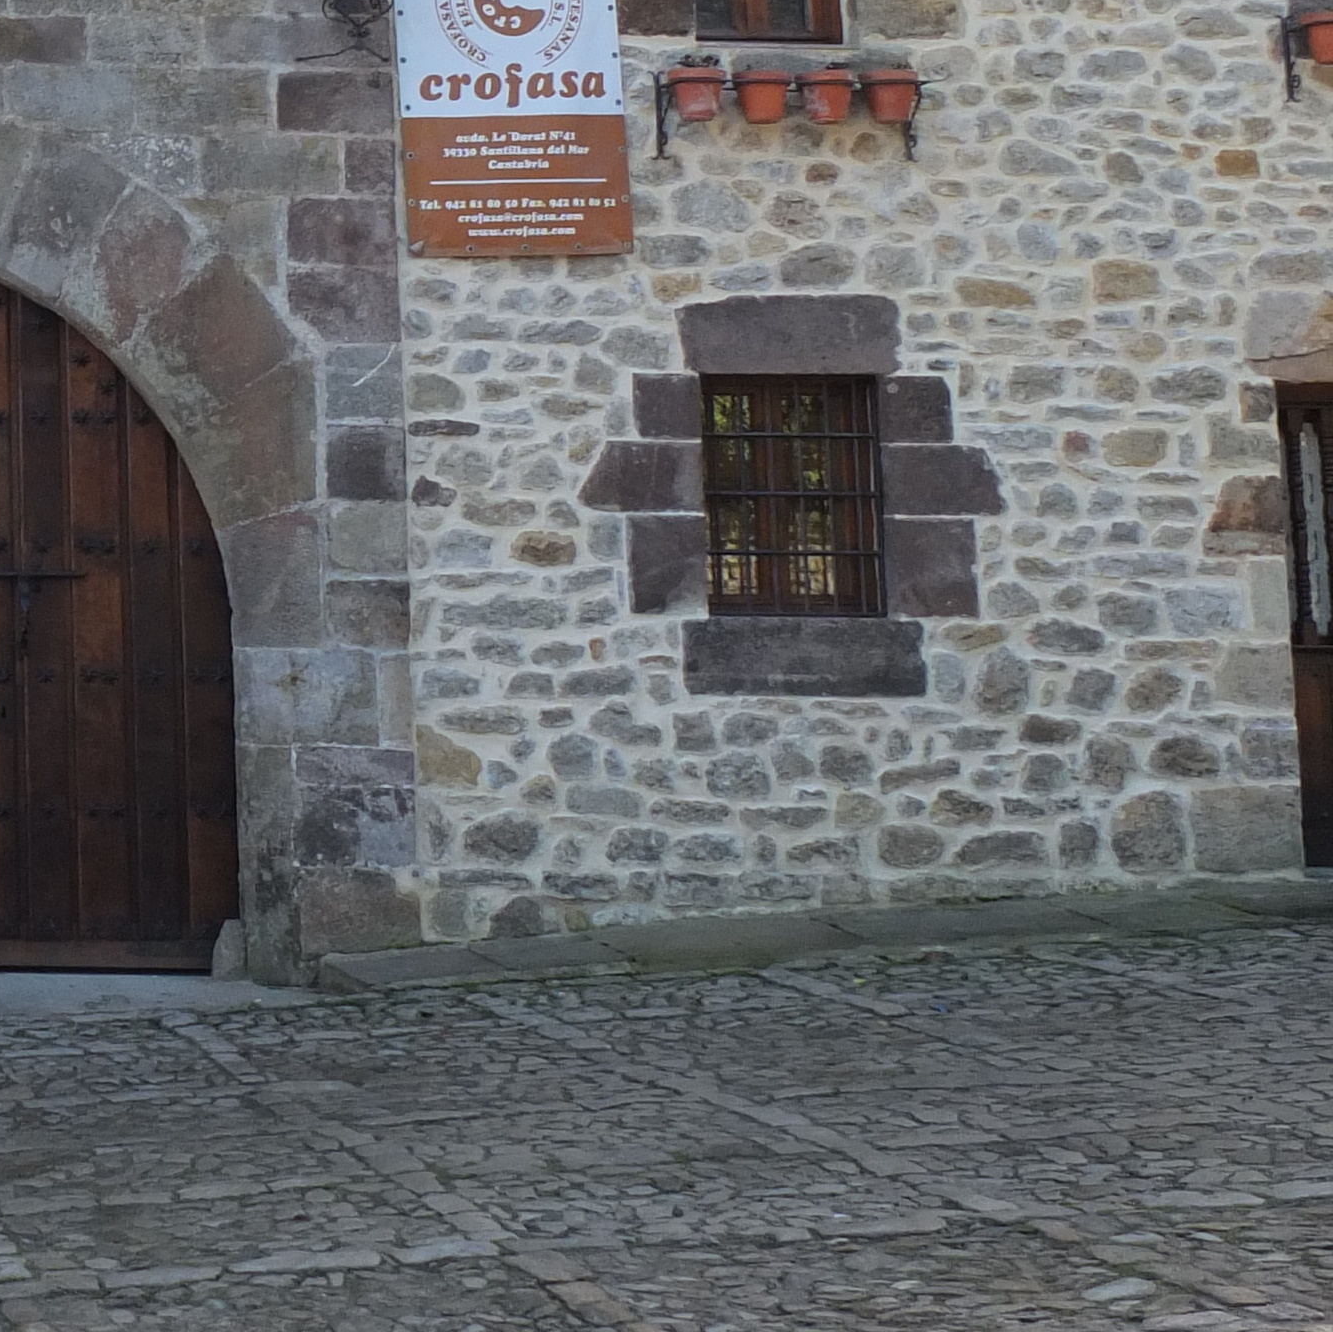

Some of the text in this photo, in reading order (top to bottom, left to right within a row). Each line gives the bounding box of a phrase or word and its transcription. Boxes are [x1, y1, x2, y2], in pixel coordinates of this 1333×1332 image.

[439, 1, 486, 62] CROFASA
[419, 63, 607, 109] crofasa
[442, 144, 590, 158] 39330 Santillana del Mar
[488, 159, 550, 170] Cantabria
[419, 199, 442, 210] Tel.
[445, 200, 466, 210] 942
[504, 199, 518, 209] 50
[521, 197, 547, 208] Fax.
[548, 198, 570, 209] 942
[603, 198, 616, 208] 51
[457, 211, 584, 224] crofasa@crofasa.com
[468, 225, 576, 238] www.crofasa.com
